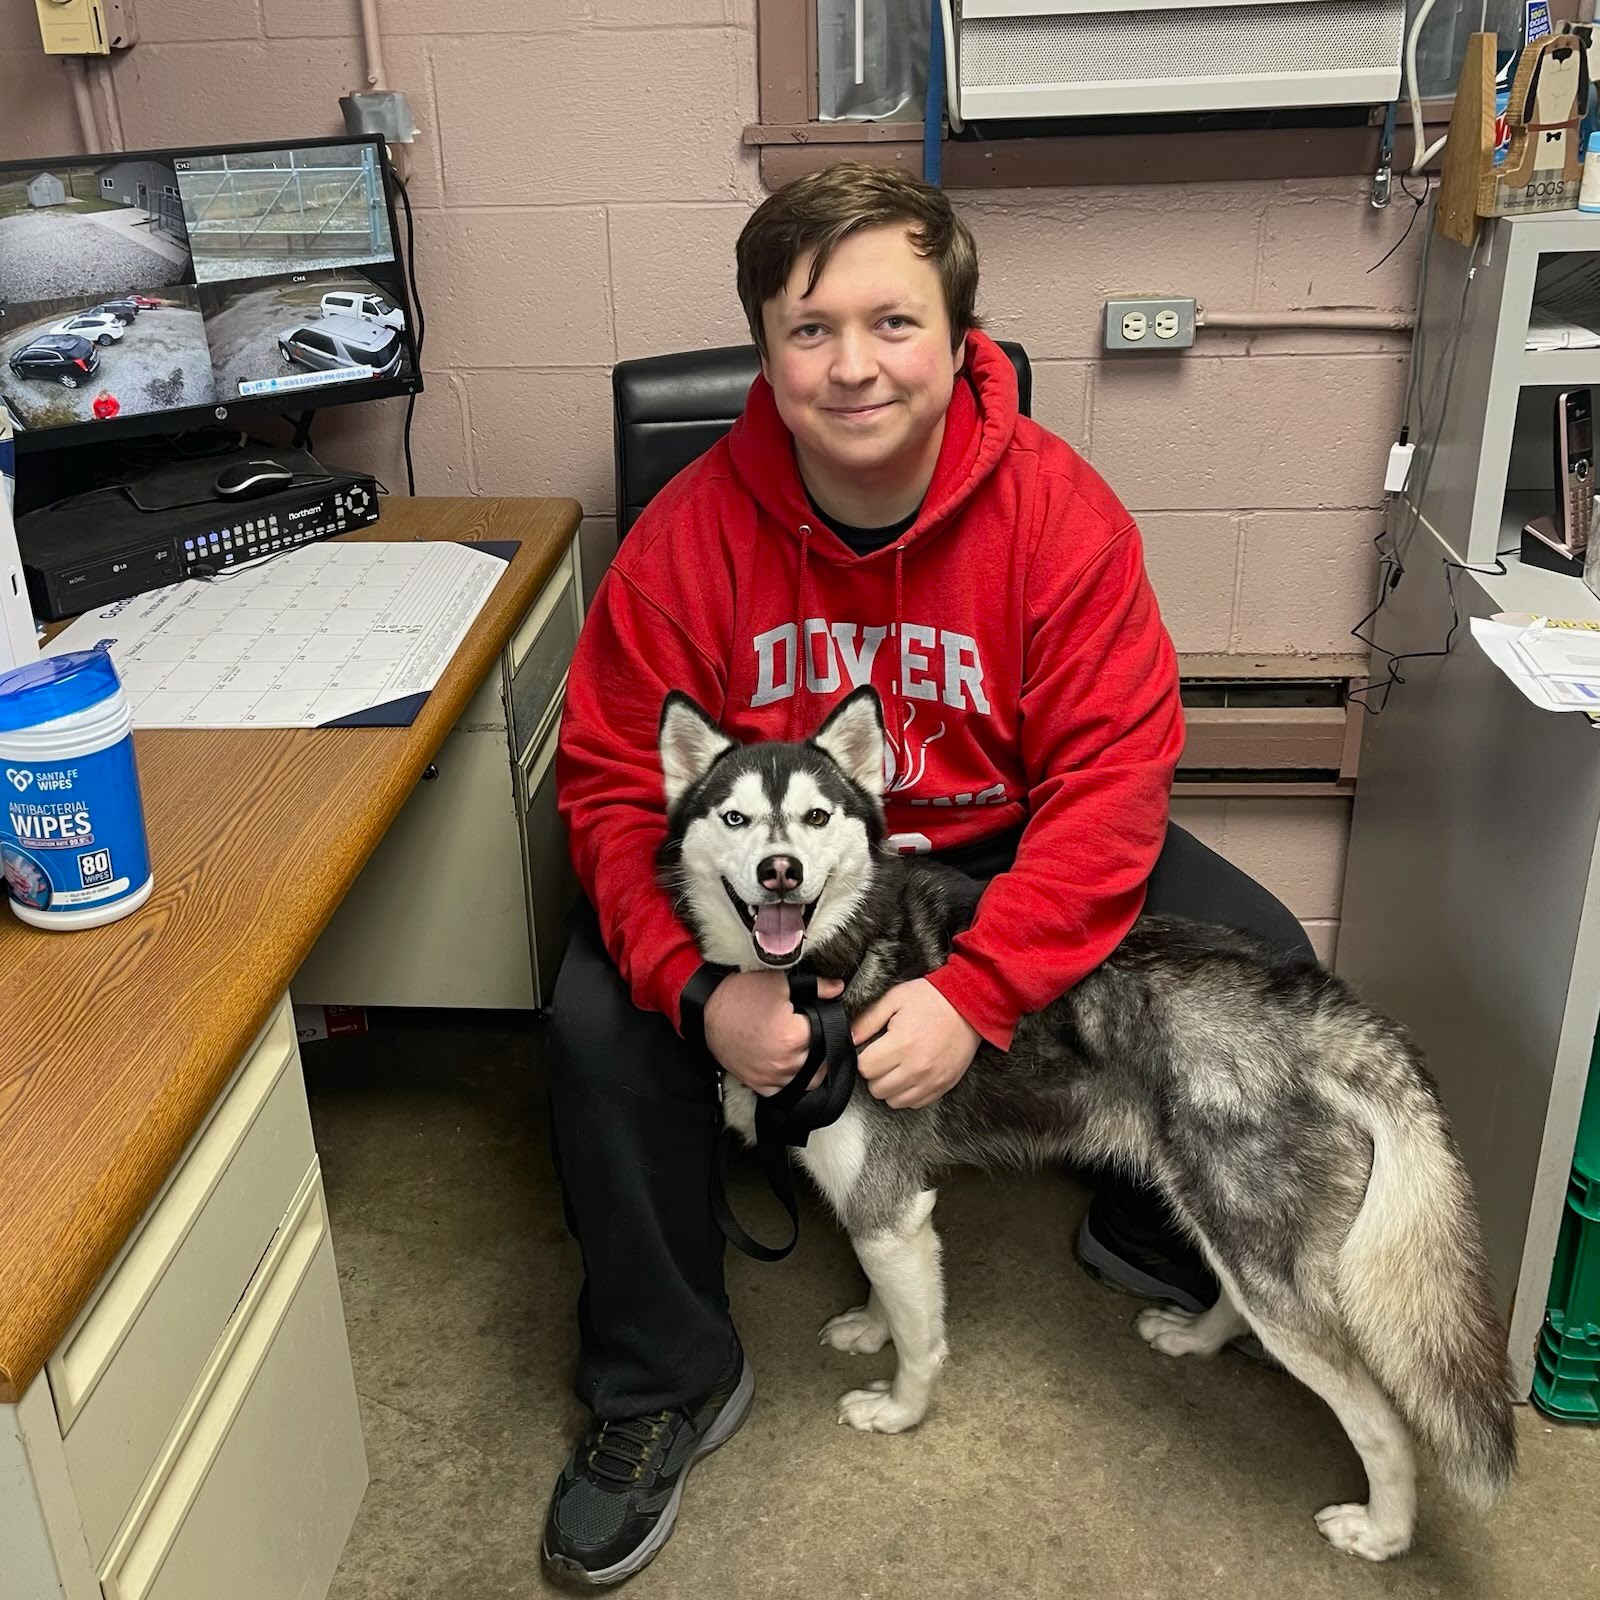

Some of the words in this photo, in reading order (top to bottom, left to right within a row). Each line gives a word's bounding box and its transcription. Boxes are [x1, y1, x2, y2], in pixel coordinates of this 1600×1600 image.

[1526, 181, 1564, 198] DOGS
[750, 618, 991, 716] DOVER
[36, 772, 65, 782] SANTA
[67, 768, 78, 778] FE
[37, 779, 72, 791] WIPES
[9, 800, 89, 815] ANTIBACTERIAL
[10, 812, 92, 839] WIPES
[82, 852, 108, 875] 80
[85, 871, 109, 884] WIPES
